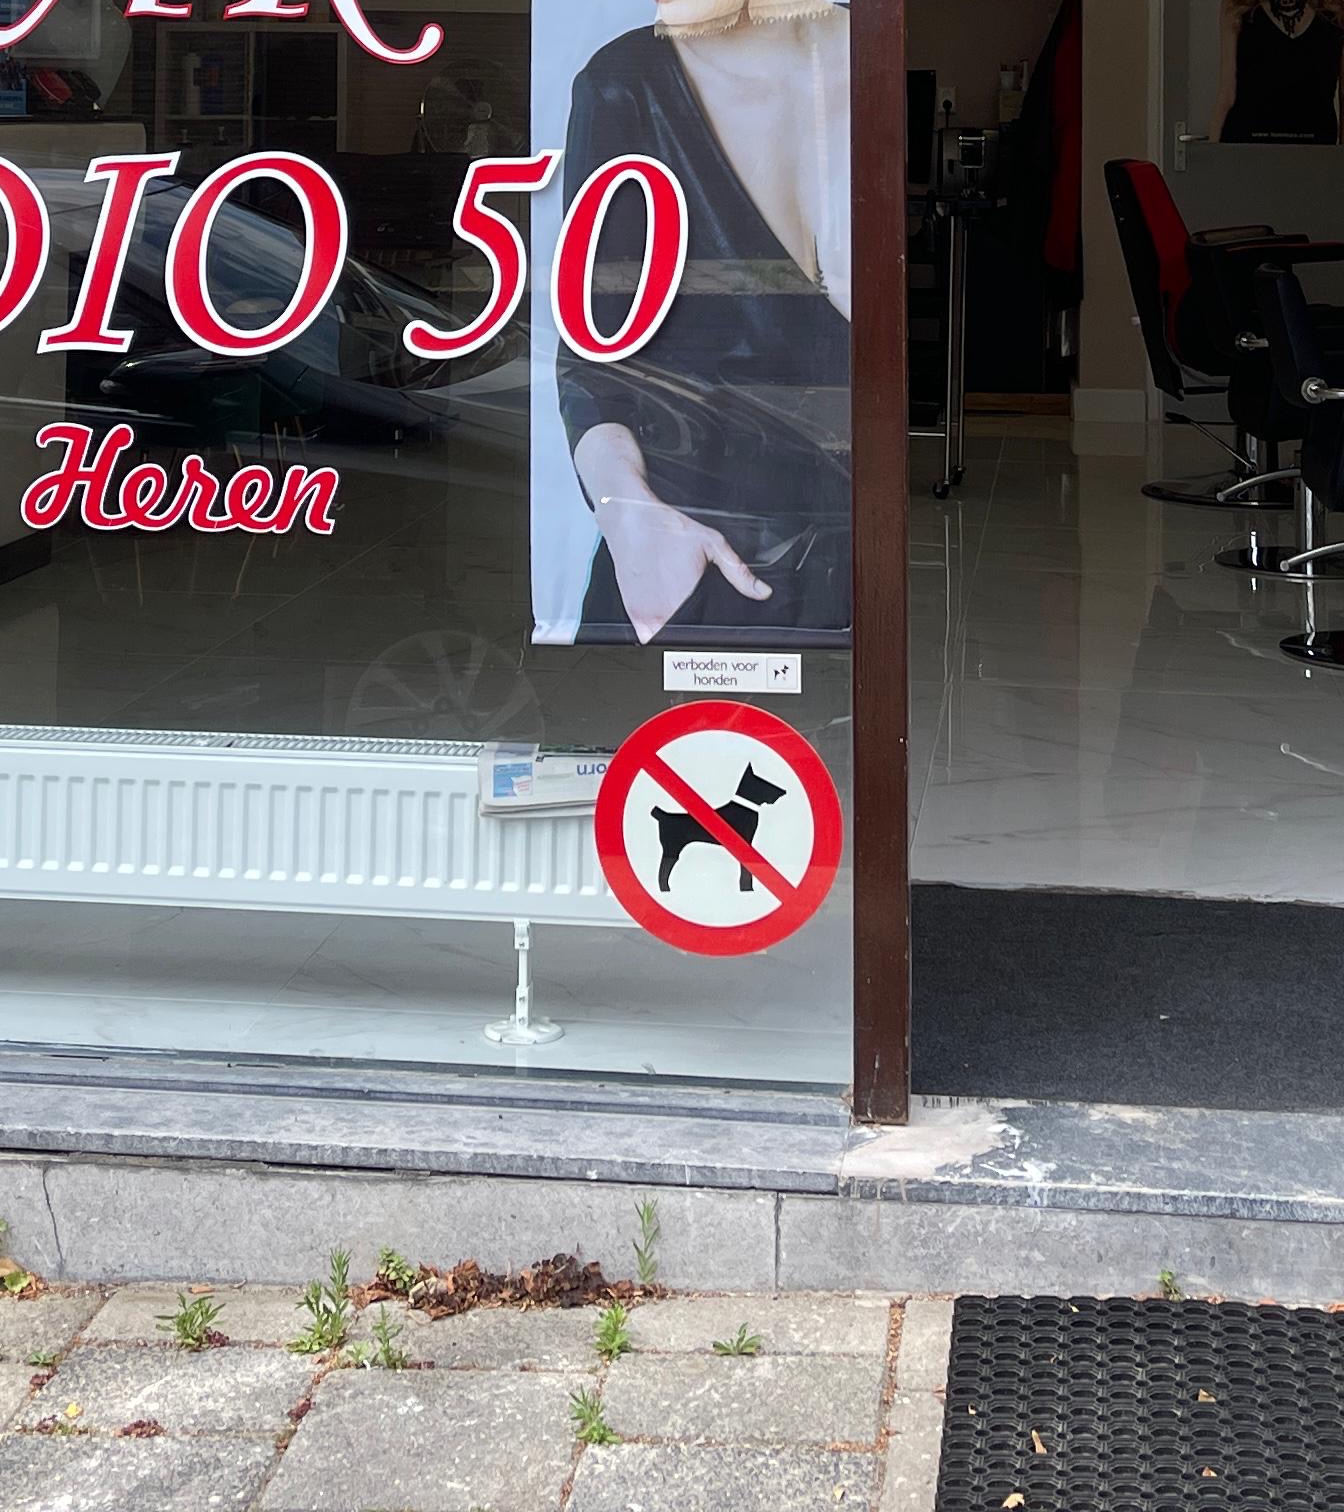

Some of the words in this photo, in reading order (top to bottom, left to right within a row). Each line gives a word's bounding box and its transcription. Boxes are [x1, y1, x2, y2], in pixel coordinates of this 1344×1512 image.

[403, 147, 690, 363] 50
[20, 421, 340, 538] Heren
[672, 658, 728, 671] verboden
[731, 661, 759, 672] voor
[693, 674, 738, 686] honden
